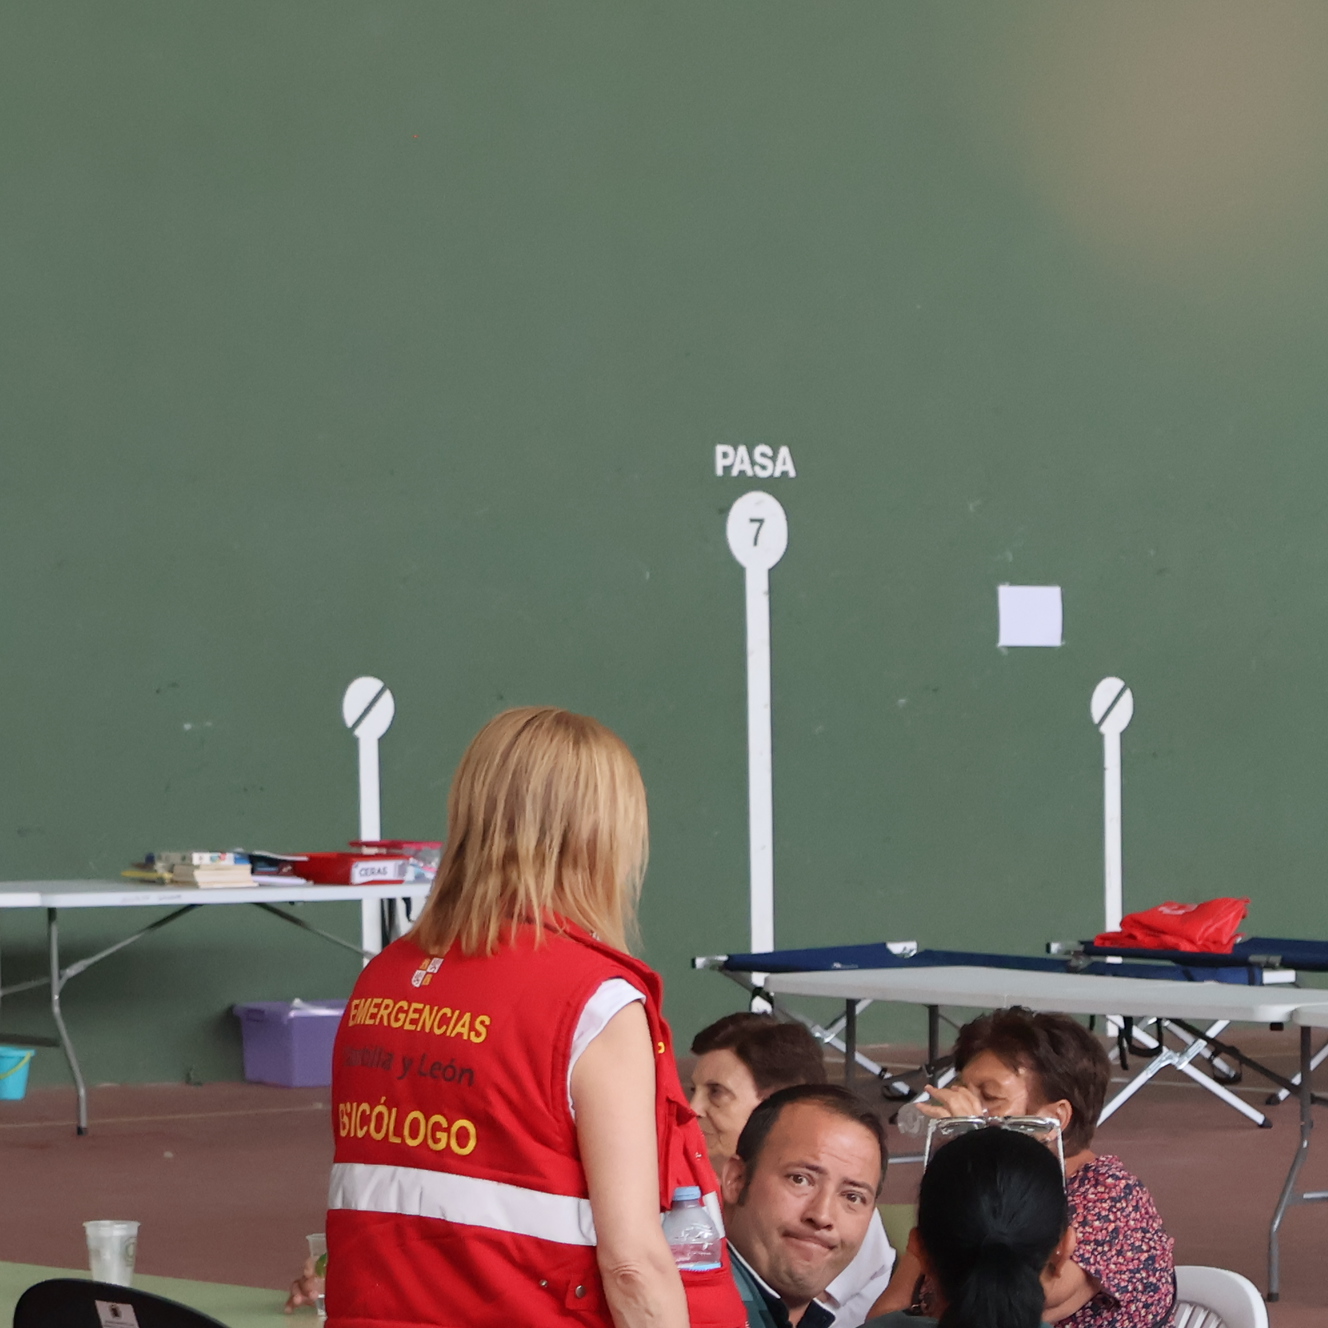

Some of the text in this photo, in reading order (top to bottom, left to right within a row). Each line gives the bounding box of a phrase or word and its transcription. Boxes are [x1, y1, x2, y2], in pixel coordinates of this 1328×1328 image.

[715, 443, 797, 479] PASA
[748, 517, 765, 547] 7
[348, 998, 491, 1044] EMERGENCIAS
[396, 1055, 413, 1081] y
[417, 1052, 476, 1087] León
